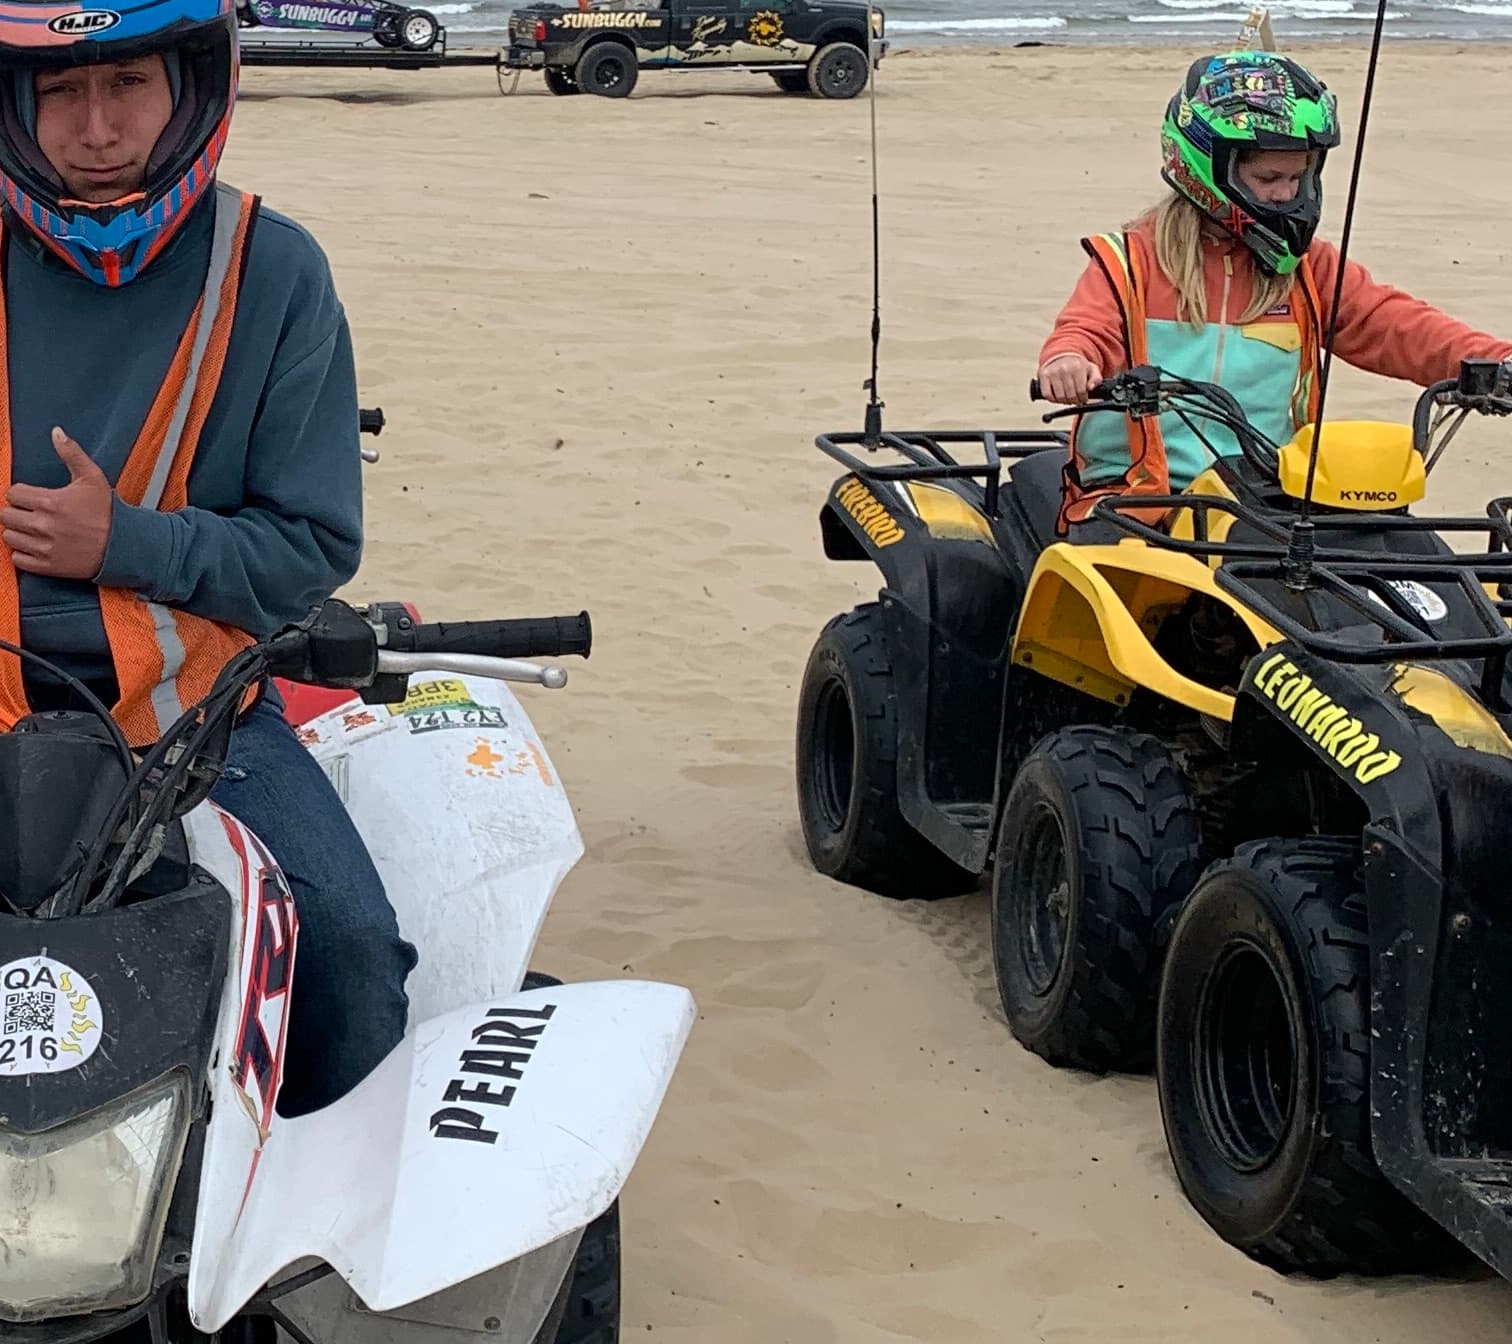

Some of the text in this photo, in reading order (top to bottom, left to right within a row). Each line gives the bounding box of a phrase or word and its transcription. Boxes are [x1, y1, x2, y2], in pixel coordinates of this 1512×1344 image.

[58, 14, 108, 30] HJC
[278, 3, 358, 26] SUNBUGGY
[1340, 490, 1397, 502] KYMCO
[835, 477, 905, 548] FIREBIRD
[1253, 653, 1402, 784] LEONARDO
[4, 966, 58, 990] QA
[429, 1004, 557, 1144] PEARL
